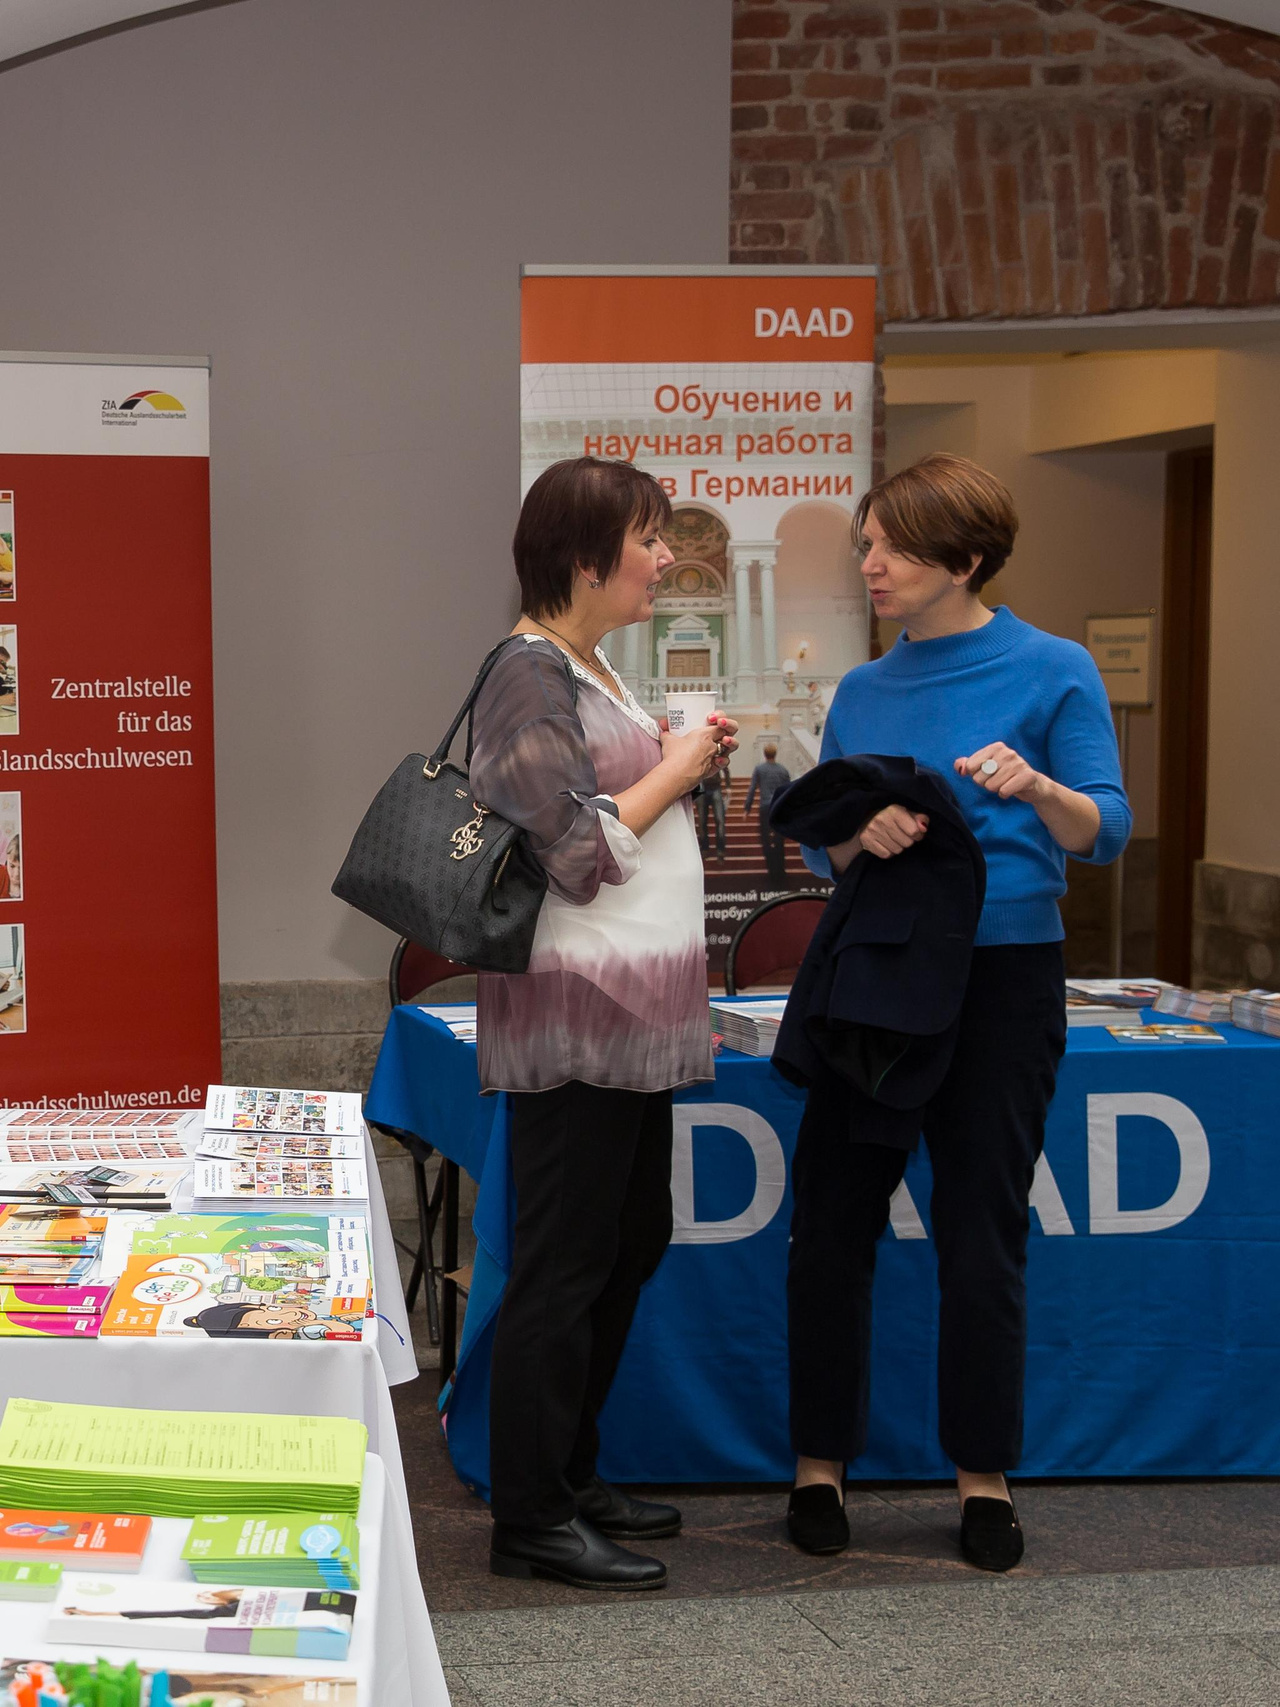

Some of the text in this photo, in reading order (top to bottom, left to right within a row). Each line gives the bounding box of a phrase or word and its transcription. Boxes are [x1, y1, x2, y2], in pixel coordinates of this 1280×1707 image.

[754, 307, 854, 338] DAAD
[101, 400, 117, 411] ZfA
[653, 384, 853, 421] Обучение и
[101, 411, 187, 420] Deutsche Auslandsschularbeit
[101, 419, 138, 428] International
[584, 426, 853, 462] научная работа
[662, 469, 853, 504] в Германии
[51, 675, 192, 700] Zentralstelle
[117, 711, 192, 733] für das
[140, 1281, 165, 1294] der
[165, 1279, 190, 1293] das
[153, 1290, 178, 1303] die
